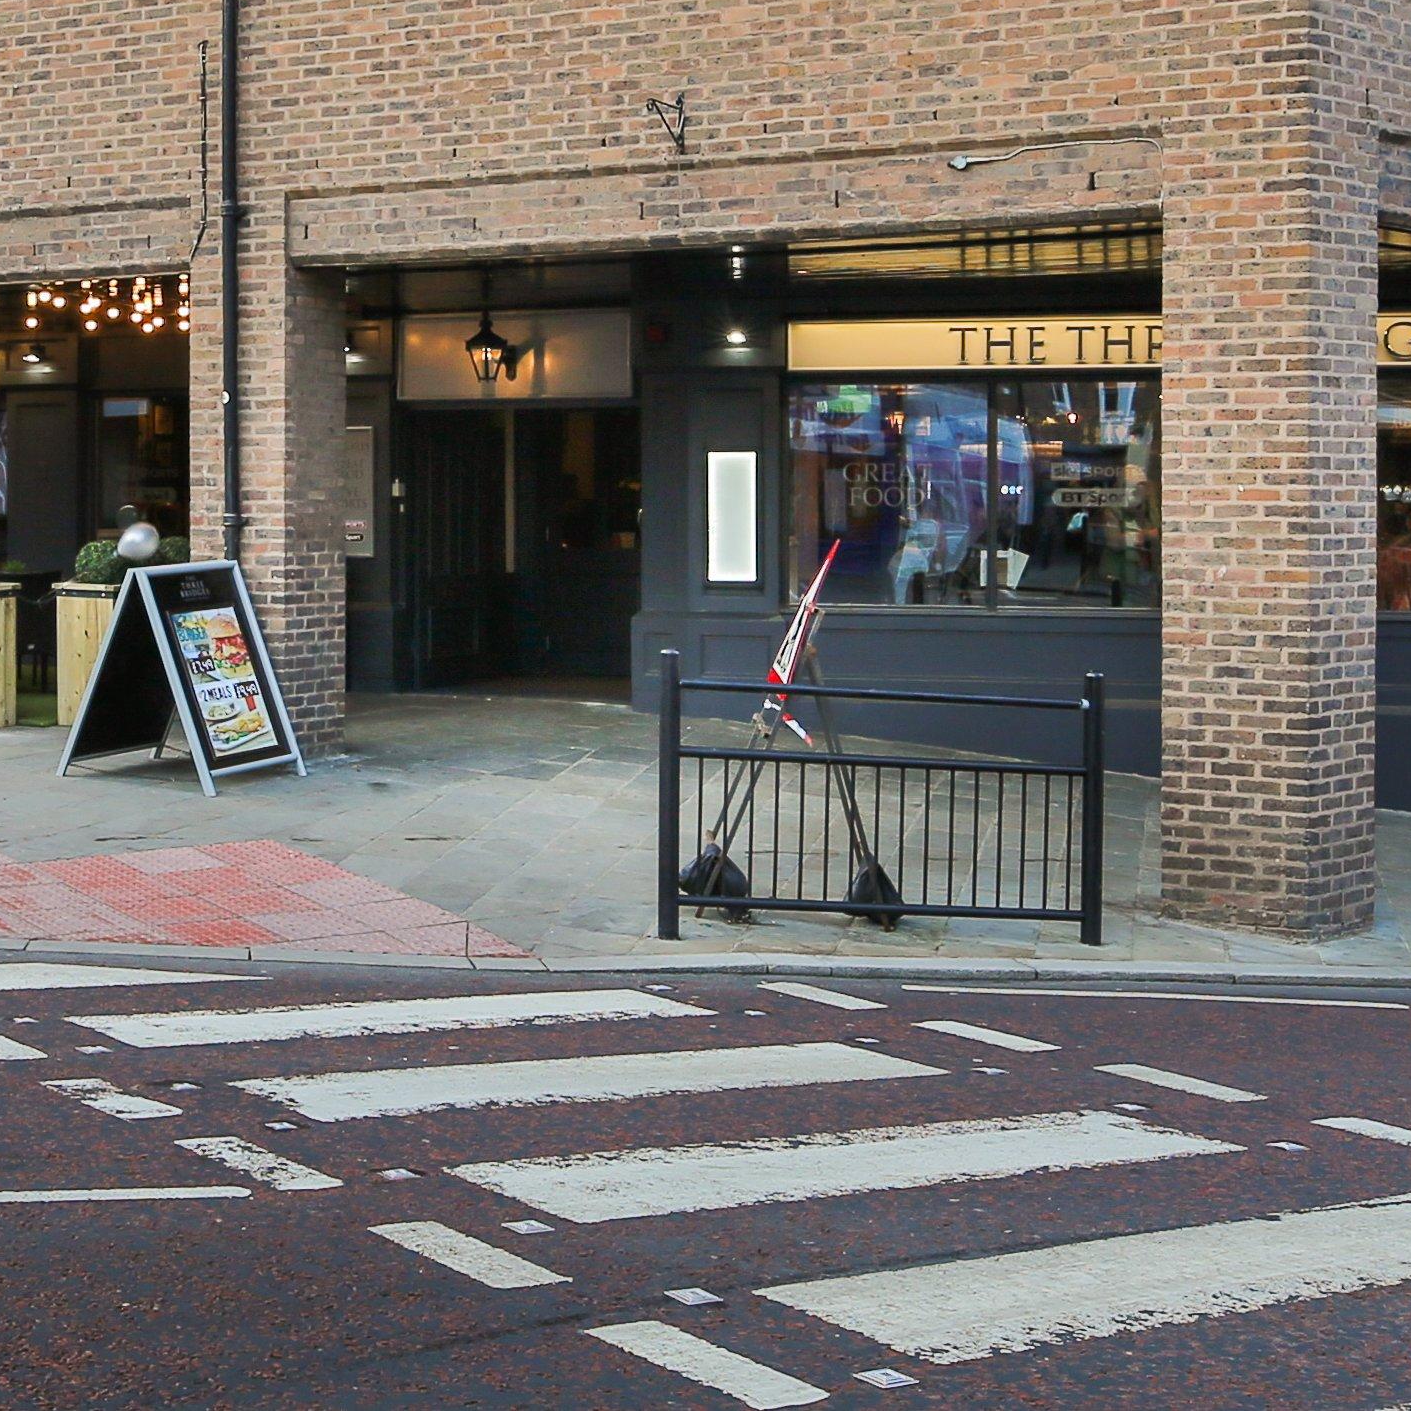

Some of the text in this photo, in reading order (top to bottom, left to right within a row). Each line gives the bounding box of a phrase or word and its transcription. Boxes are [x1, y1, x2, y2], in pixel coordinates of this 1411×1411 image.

[949, 326, 1046, 365] THE
[843, 463, 932, 484] GREAT
[849, 486, 926, 508] FOOD
[1061, 492, 1086, 503] BT
